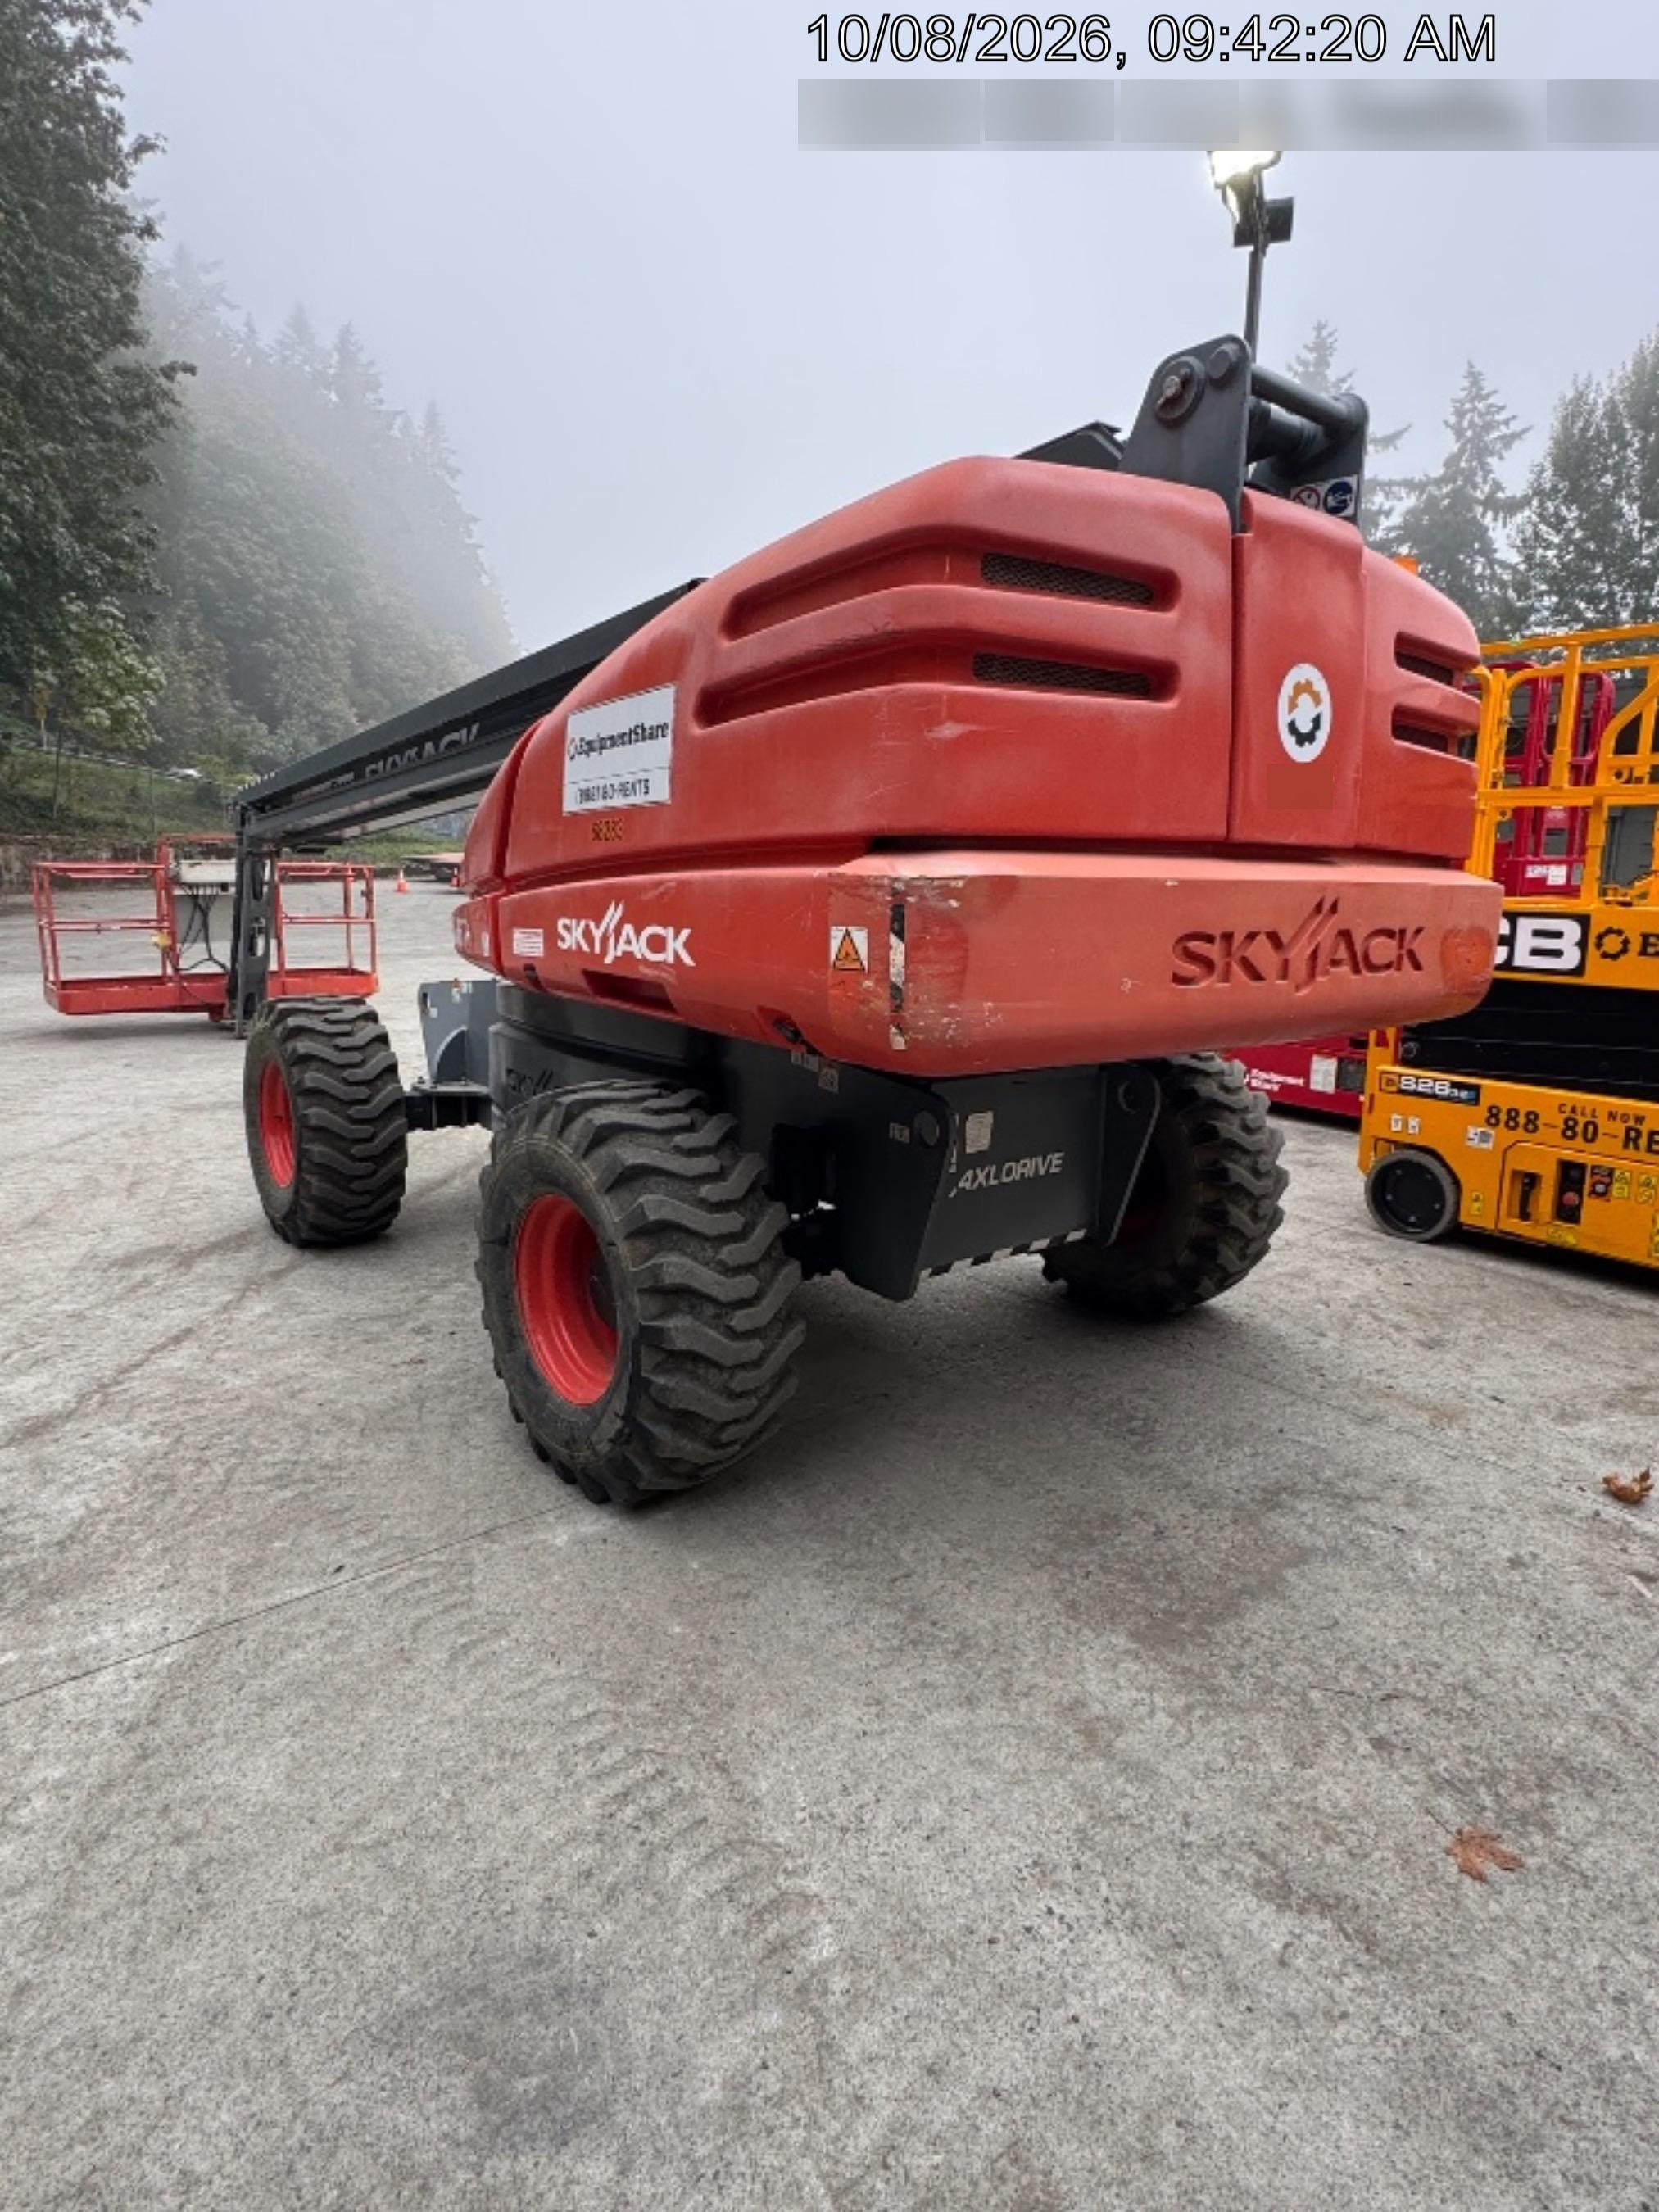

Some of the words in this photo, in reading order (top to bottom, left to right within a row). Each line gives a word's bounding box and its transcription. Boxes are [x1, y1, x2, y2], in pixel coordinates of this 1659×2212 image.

[557, 900, 696, 967] SKYJACK
[1172, 895, 1425, 996] SKYJACK
[1558, 1103, 1599, 1119] CALL
[1607, 1110, 1647, 1126] NOW
